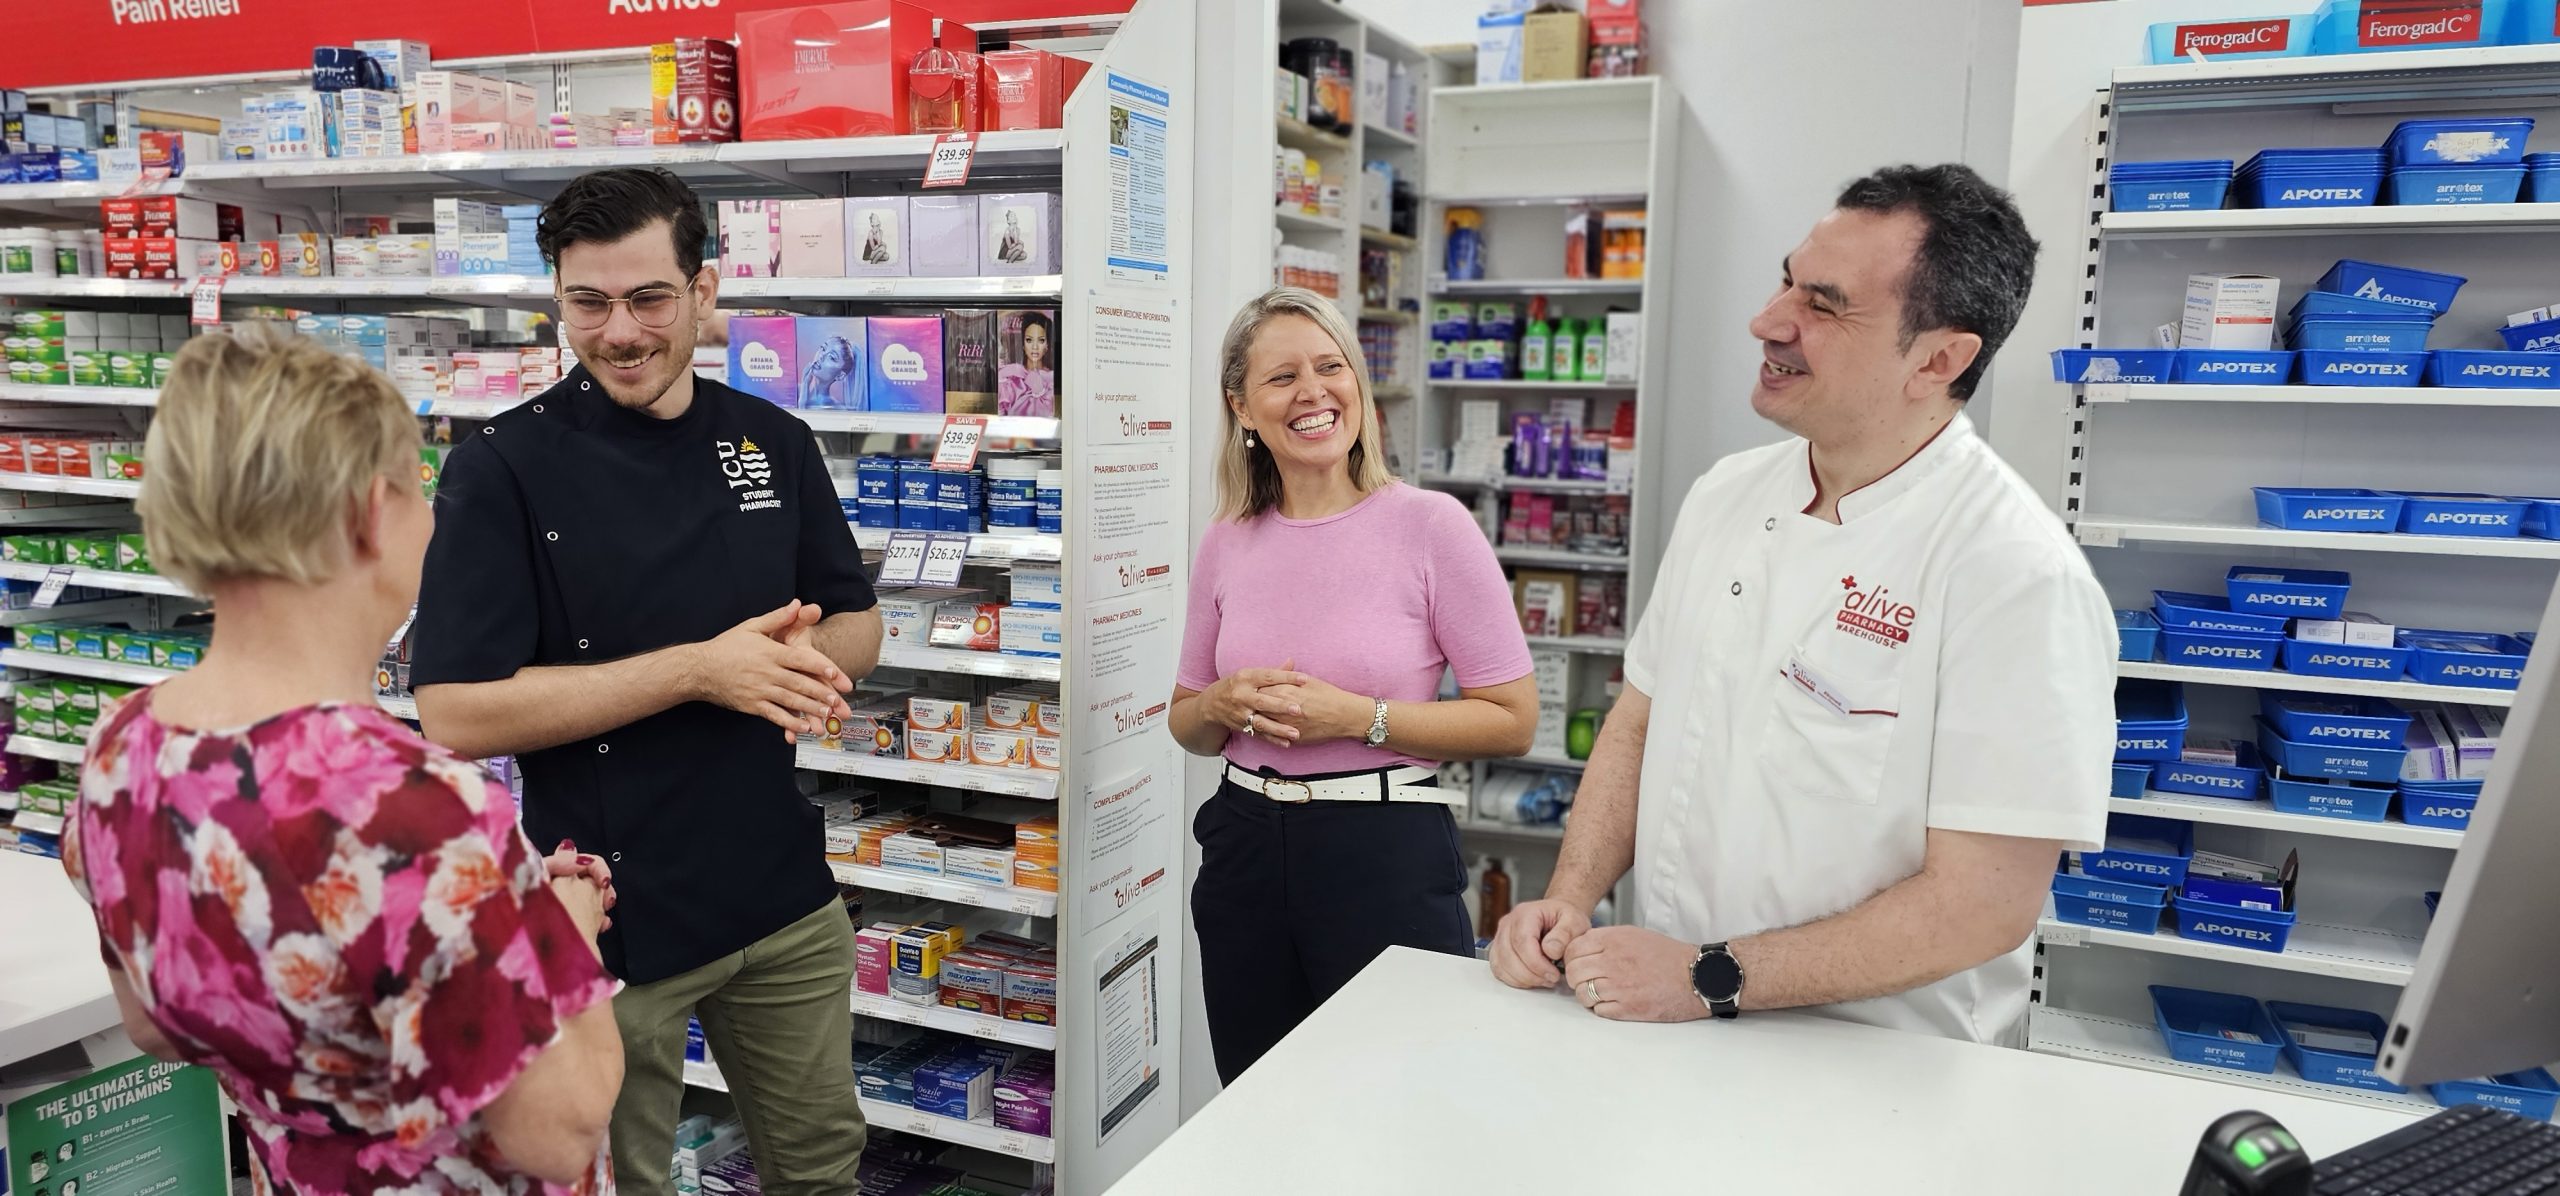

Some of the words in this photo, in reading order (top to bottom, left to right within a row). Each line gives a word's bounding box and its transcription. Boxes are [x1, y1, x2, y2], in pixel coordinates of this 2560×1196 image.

[111, 0, 167, 25] Pain
[169, 0, 240, 20] Relief
[2369, 18, 2446, 40] Ferro-grad
[2184, 29, 2256, 49] Ferro-grad
[937, 148, 972, 162] $39.99
[2281, 188, 2363, 201] APOTEX
[2380, 293, 2437, 310] APOTEX
[958, 343, 984, 358] RiRi
[2198, 362, 2277, 374] APOTEX
[2323, 362, 2409, 376] APOTEX
[2461, 364, 2551, 378] APOTEX
[1122, 412, 1147, 437] alive
[943, 430, 978, 446] $39.99
[716, 440, 754, 490] JCU
[742, 490, 774, 501] STUDENT
[739, 500, 782, 513] PHARMACIST
[2303, 508, 2385, 521] APOTEX
[2424, 512, 2509, 526] APOTEX
[887, 545, 920, 560] $27.74
[929, 546, 963, 561] $26.24
[1121, 564, 1146, 588] alive
[1844, 584, 1916, 628] alive
[2246, 593, 2328, 608] APOTEX
[1839, 611, 1905, 640] PHARMACY
[1835, 623, 1899, 650] WAREHOUSE
[2183, 644, 2263, 660] APOTEX
[2308, 654, 2392, 670] APOTEX
[991, 703, 1011, 711] Voltaren
[1117, 707, 1144, 733] alive
[842, 727, 873, 736] NUROFEN
[2309, 726, 2391, 740] APOTEX
[1036, 744, 1057, 752] Voltaren
[2117, 739, 2169, 750] OTEX
[2168, 772, 2245, 789] APOTEX
[2422, 806, 2472, 819] APO
[2096, 858, 2172, 876] APOTEX
[1117, 881, 1141, 908] alive
[2193, 922, 2273, 943] APOTEX
[947, 971, 991, 984] maxigesic
[36, 1098, 69, 1121] THE
[72, 1069, 145, 1108] ULTIMATE
[149, 1061, 192, 1080] GUID
[61, 1113, 83, 1129] TO
[87, 1107, 98, 1121] B
[102, 1076, 173, 1114] VITAMINS
[995, 1101, 1011, 1110] Night
[1023, 1105, 1039, 1114] Relief
[82, 1133, 93, 1145] B1
[100, 1122, 124, 1138] Energy
[131, 1114, 150, 1126] Brain
[85, 1170, 98, 1182] B2
[106, 1158, 134, 1173] Migraine
[135, 1145, 162, 1161] Support
